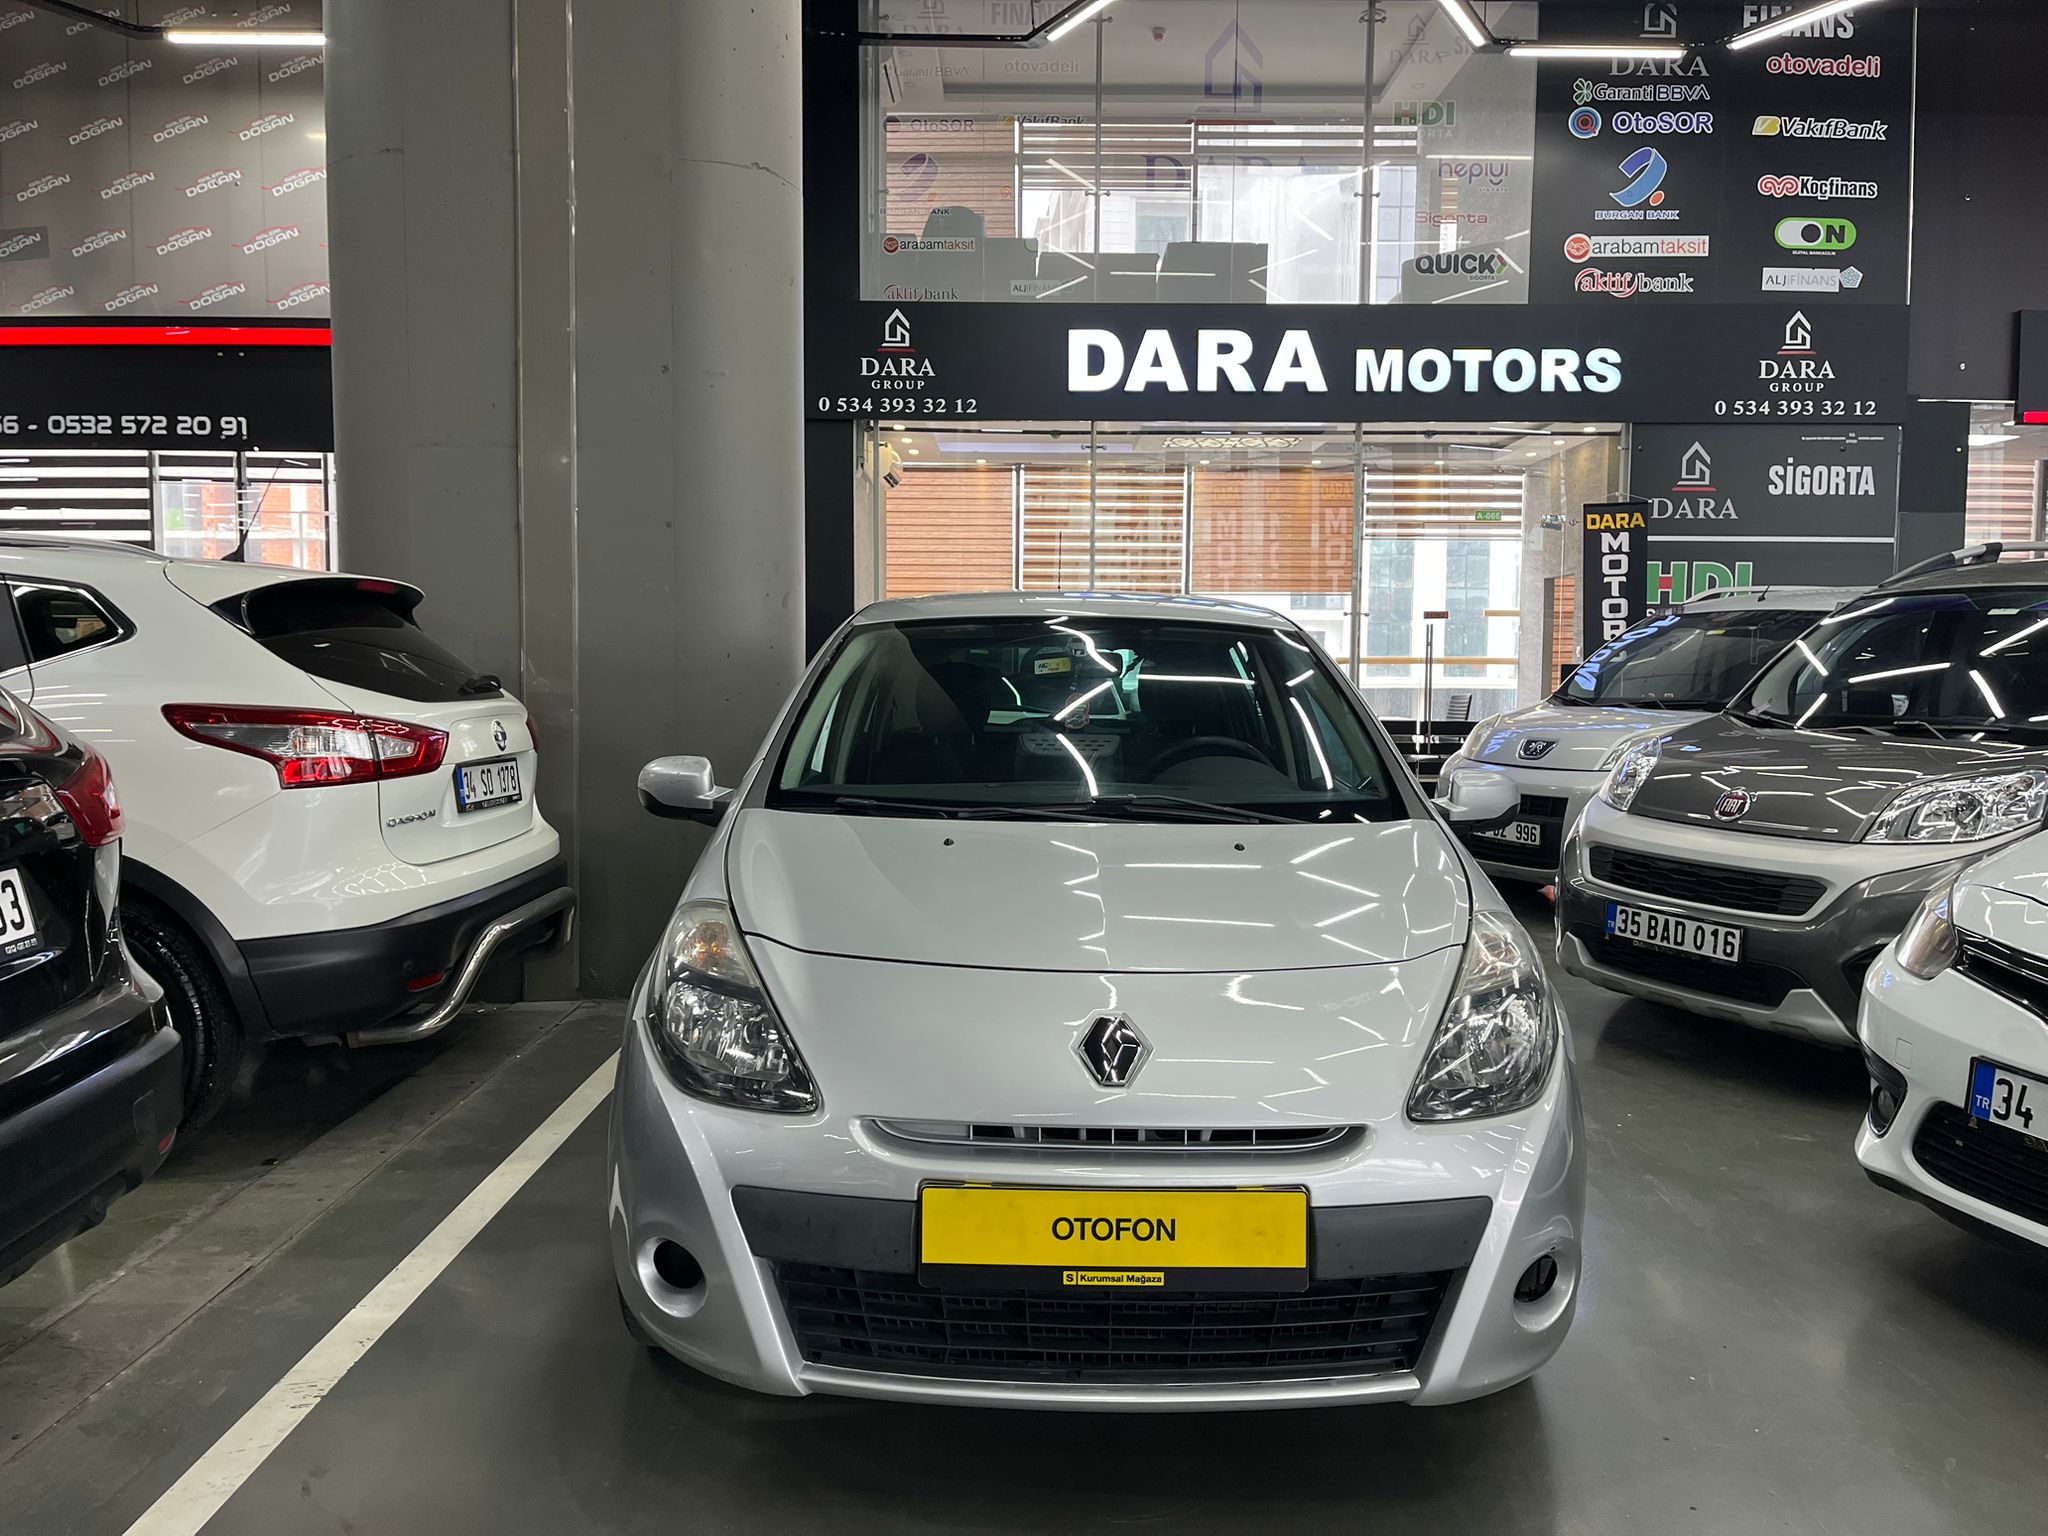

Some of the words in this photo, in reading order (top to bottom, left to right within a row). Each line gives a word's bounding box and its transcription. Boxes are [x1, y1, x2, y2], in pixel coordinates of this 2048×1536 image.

[153, 6, 206, 28] OGAN
[1004, 60, 1080, 73] otovadeli
[1609, 56, 1710, 77] DARA
[1767, 53, 1880, 77] otovadeli
[1593, 83, 1654, 101] Garanti
[1656, 84, 1710, 101] BBVA
[1393, 100, 1457, 127] HDI
[1612, 111, 1714, 133] OtoSOR
[911, 118, 974, 132] OtoSOR
[1800, 177, 1877, 199] Koçfinans
[1595, 210, 1644, 220] BURGAN
[1646, 210, 1679, 220] BANK
[1592, 239, 1707, 255] arabamtaksit
[1415, 254, 1495, 275] QUICK
[1580, 272, 1632, 292] aktif
[1638, 272, 1694, 292] bank
[1765, 275, 1787, 286] ALJ
[924, 288, 959, 300] bank
[860, 357, 936, 378] DARA
[1066, 328, 1328, 394] DARA
[1355, 347, 1623, 394] MOTORS
[1758, 359, 1836, 380] DARA
[871, 379, 925, 390] GROUP
[1769, 381, 1825, 392] GROUP
[818, 397, 831, 413] 0
[837, 397, 873, 414] 534
[880, 397, 917, 414] 393
[923, 398, 948, 414] 32
[955, 399, 978, 415] 12
[1714, 399, 1727, 416] 0
[1733, 399, 1770, 416] 534
[1777, 399, 1814, 416] 393
[1821, 399, 1846, 416] 32
[1853, 399, 1877, 416] 12
[48, 415, 112, 435] 0532
[121, 415, 168, 435] 572
[176, 416, 212, 435] 20
[220, 416, 247, 436] 91
[1768, 457, 1876, 495] SİGORTA
[1650, 498, 1739, 520] DARA
[1586, 512, 1646, 530] DARA
[1647, 561, 1753, 605] HDI
[464, 771, 477, 800] 34
[481, 768, 494, 796] SD
[497, 765, 517, 793] 1378
[1720, 798, 1745, 813] FIAT
[1515, 824, 1537, 843] 996
[1607, 920, 1615, 928] TR
[1617, 909, 1641, 937] 35
[1647, 914, 1686, 947] BAD
[1693, 925, 1737, 958] 016
[1975, 1095, 1990, 1110] TR
[1992, 1078, 2034, 1129] 34
[1052, 1217, 1176, 1242] OTOFON
[1066, 1274, 1074, 1283] S
[1080, 1273, 1124, 1284] Kurumsal
[1126, 1274, 1162, 1286] Mağaza
